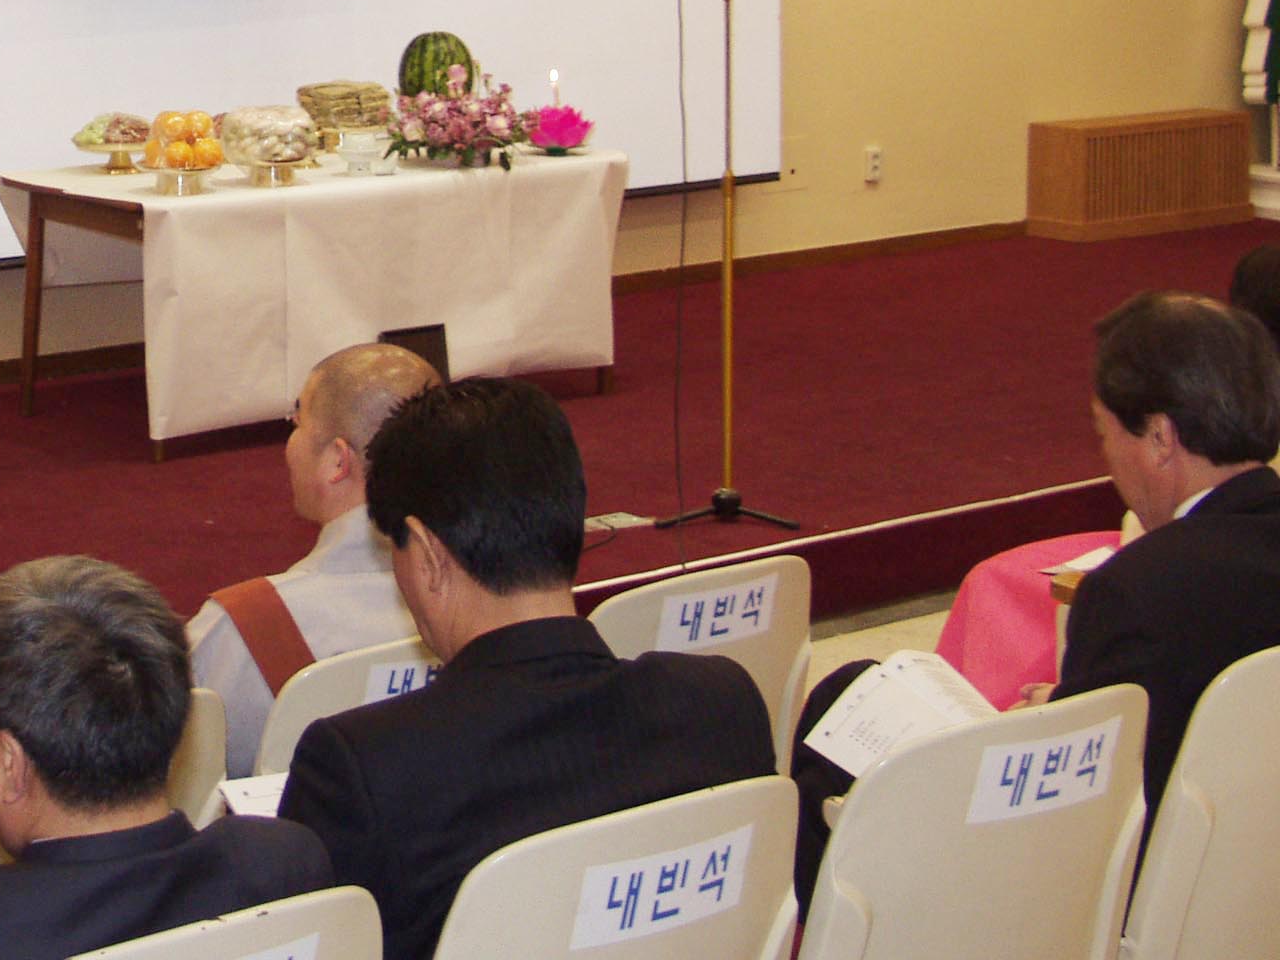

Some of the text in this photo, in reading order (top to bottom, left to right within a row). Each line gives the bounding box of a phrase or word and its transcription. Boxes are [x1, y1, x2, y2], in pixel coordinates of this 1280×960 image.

[679, 586, 765, 641] 내빈석
[999, 734, 1105, 807] 내빈석
[606, 844, 732, 930] 내빈석
